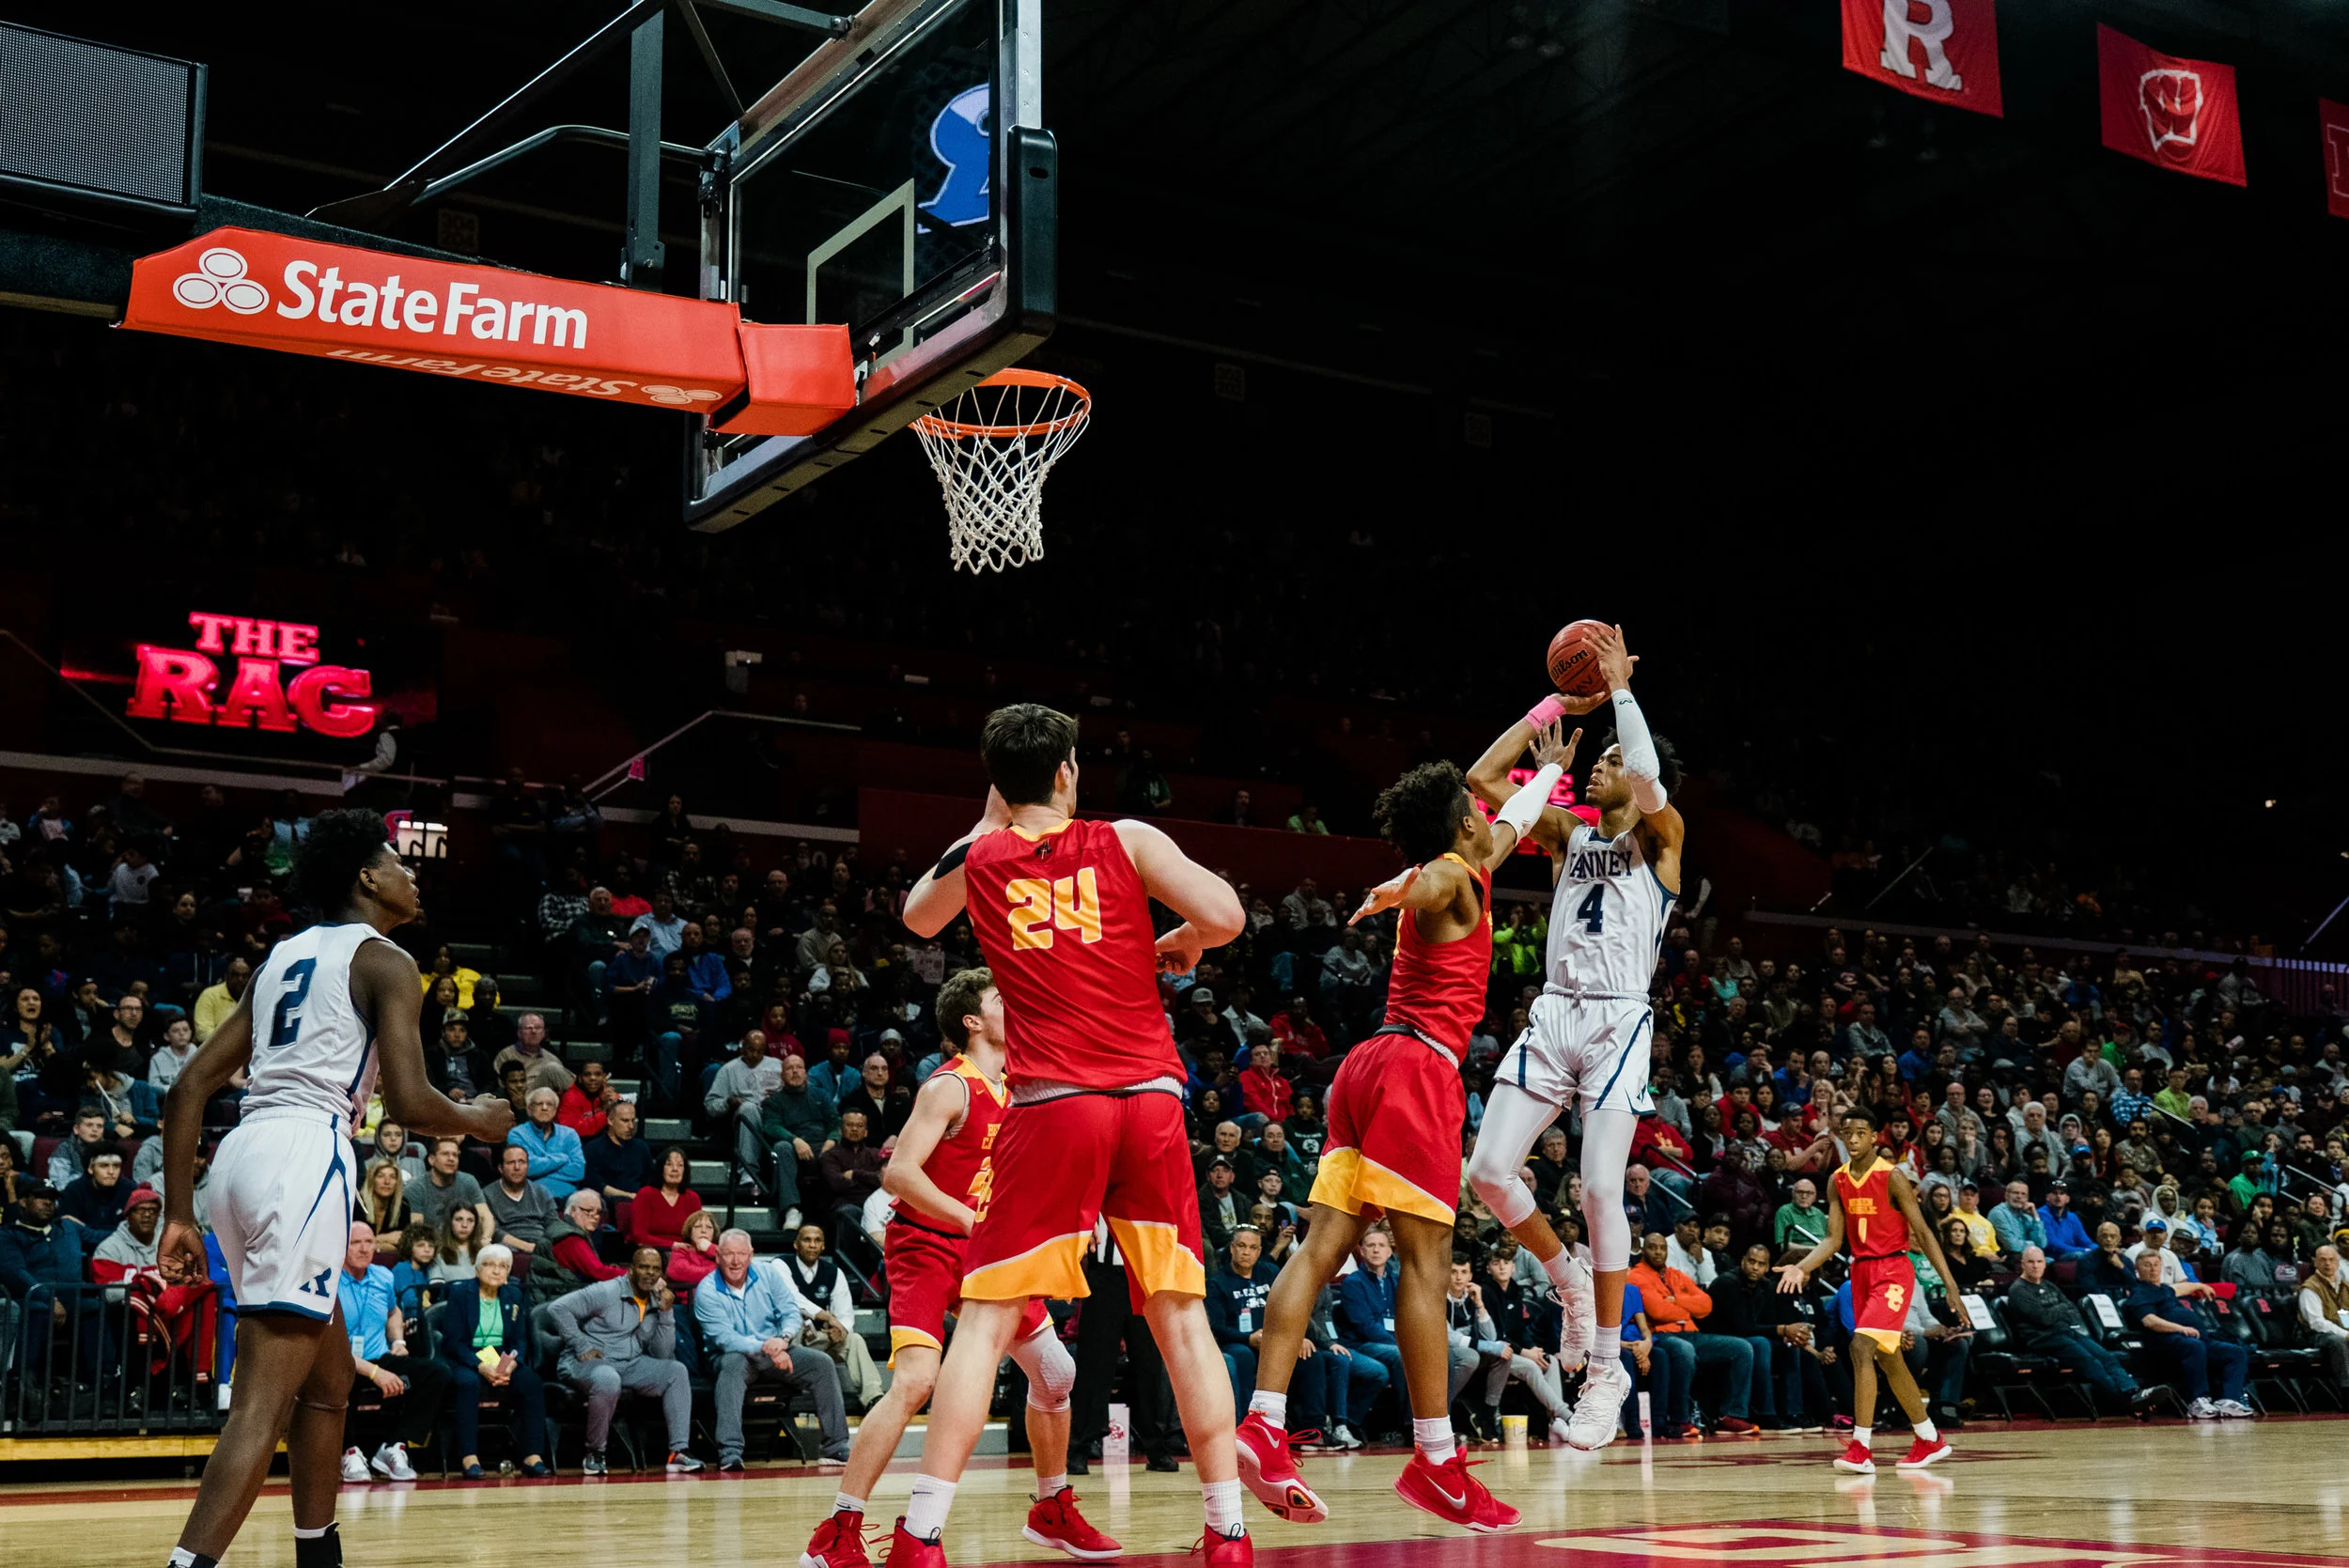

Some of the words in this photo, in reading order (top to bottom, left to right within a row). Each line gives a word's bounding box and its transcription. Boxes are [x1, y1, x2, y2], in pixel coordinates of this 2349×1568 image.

[188, 611, 320, 663] THE
[1550, 649, 1589, 681] Wilson
[1005, 866, 1102, 951] 24
[1577, 883, 1604, 935] 4
[268, 956, 317, 1049] 2
[1858, 1217, 1868, 1244] 1
